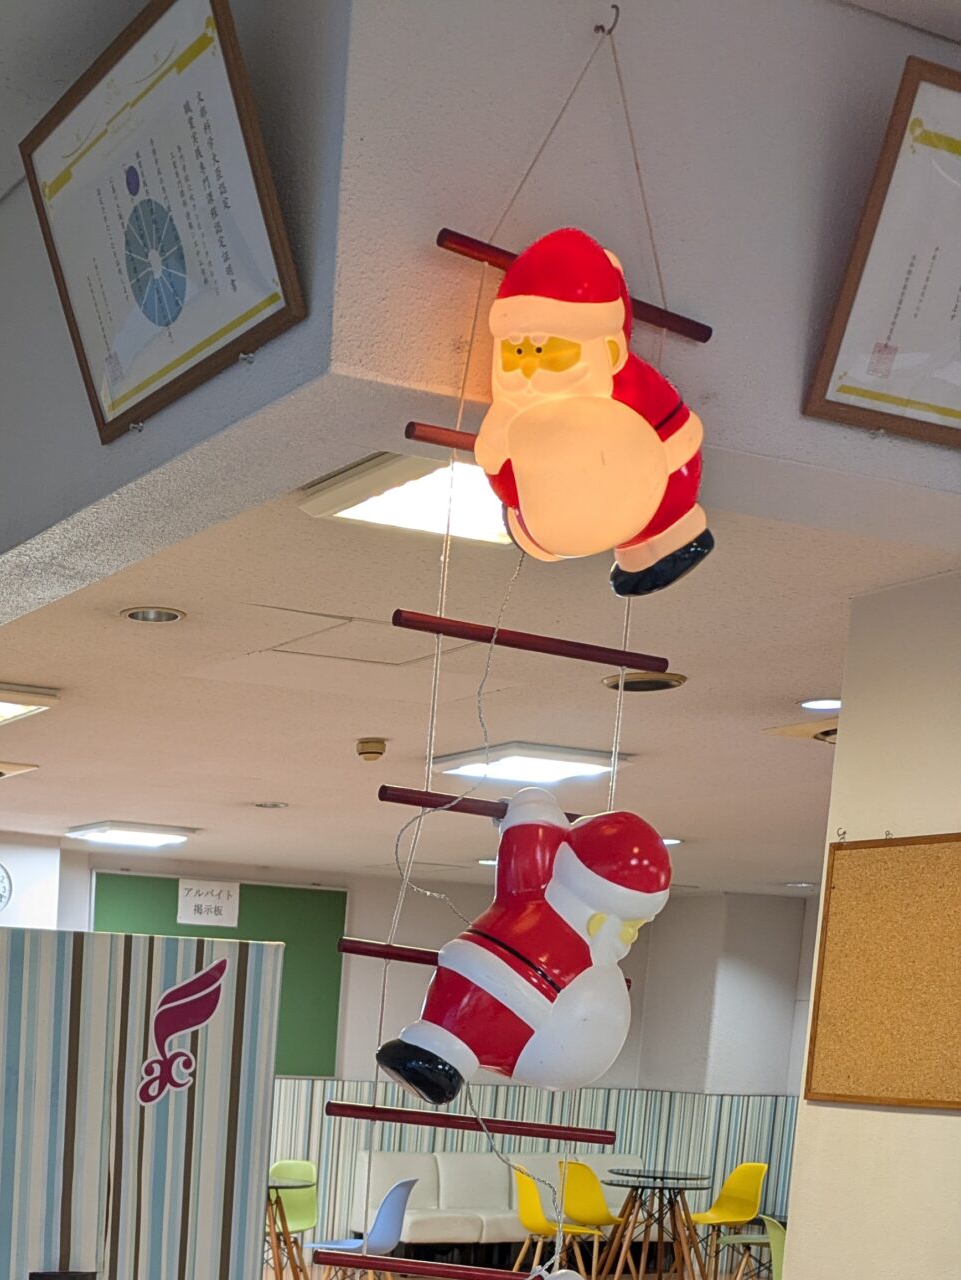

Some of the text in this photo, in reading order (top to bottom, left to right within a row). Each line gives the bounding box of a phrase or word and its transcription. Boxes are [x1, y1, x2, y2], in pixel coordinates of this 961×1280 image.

[183, 887, 234, 901] アルバイト
[193, 903, 224, 916] 掲示板
